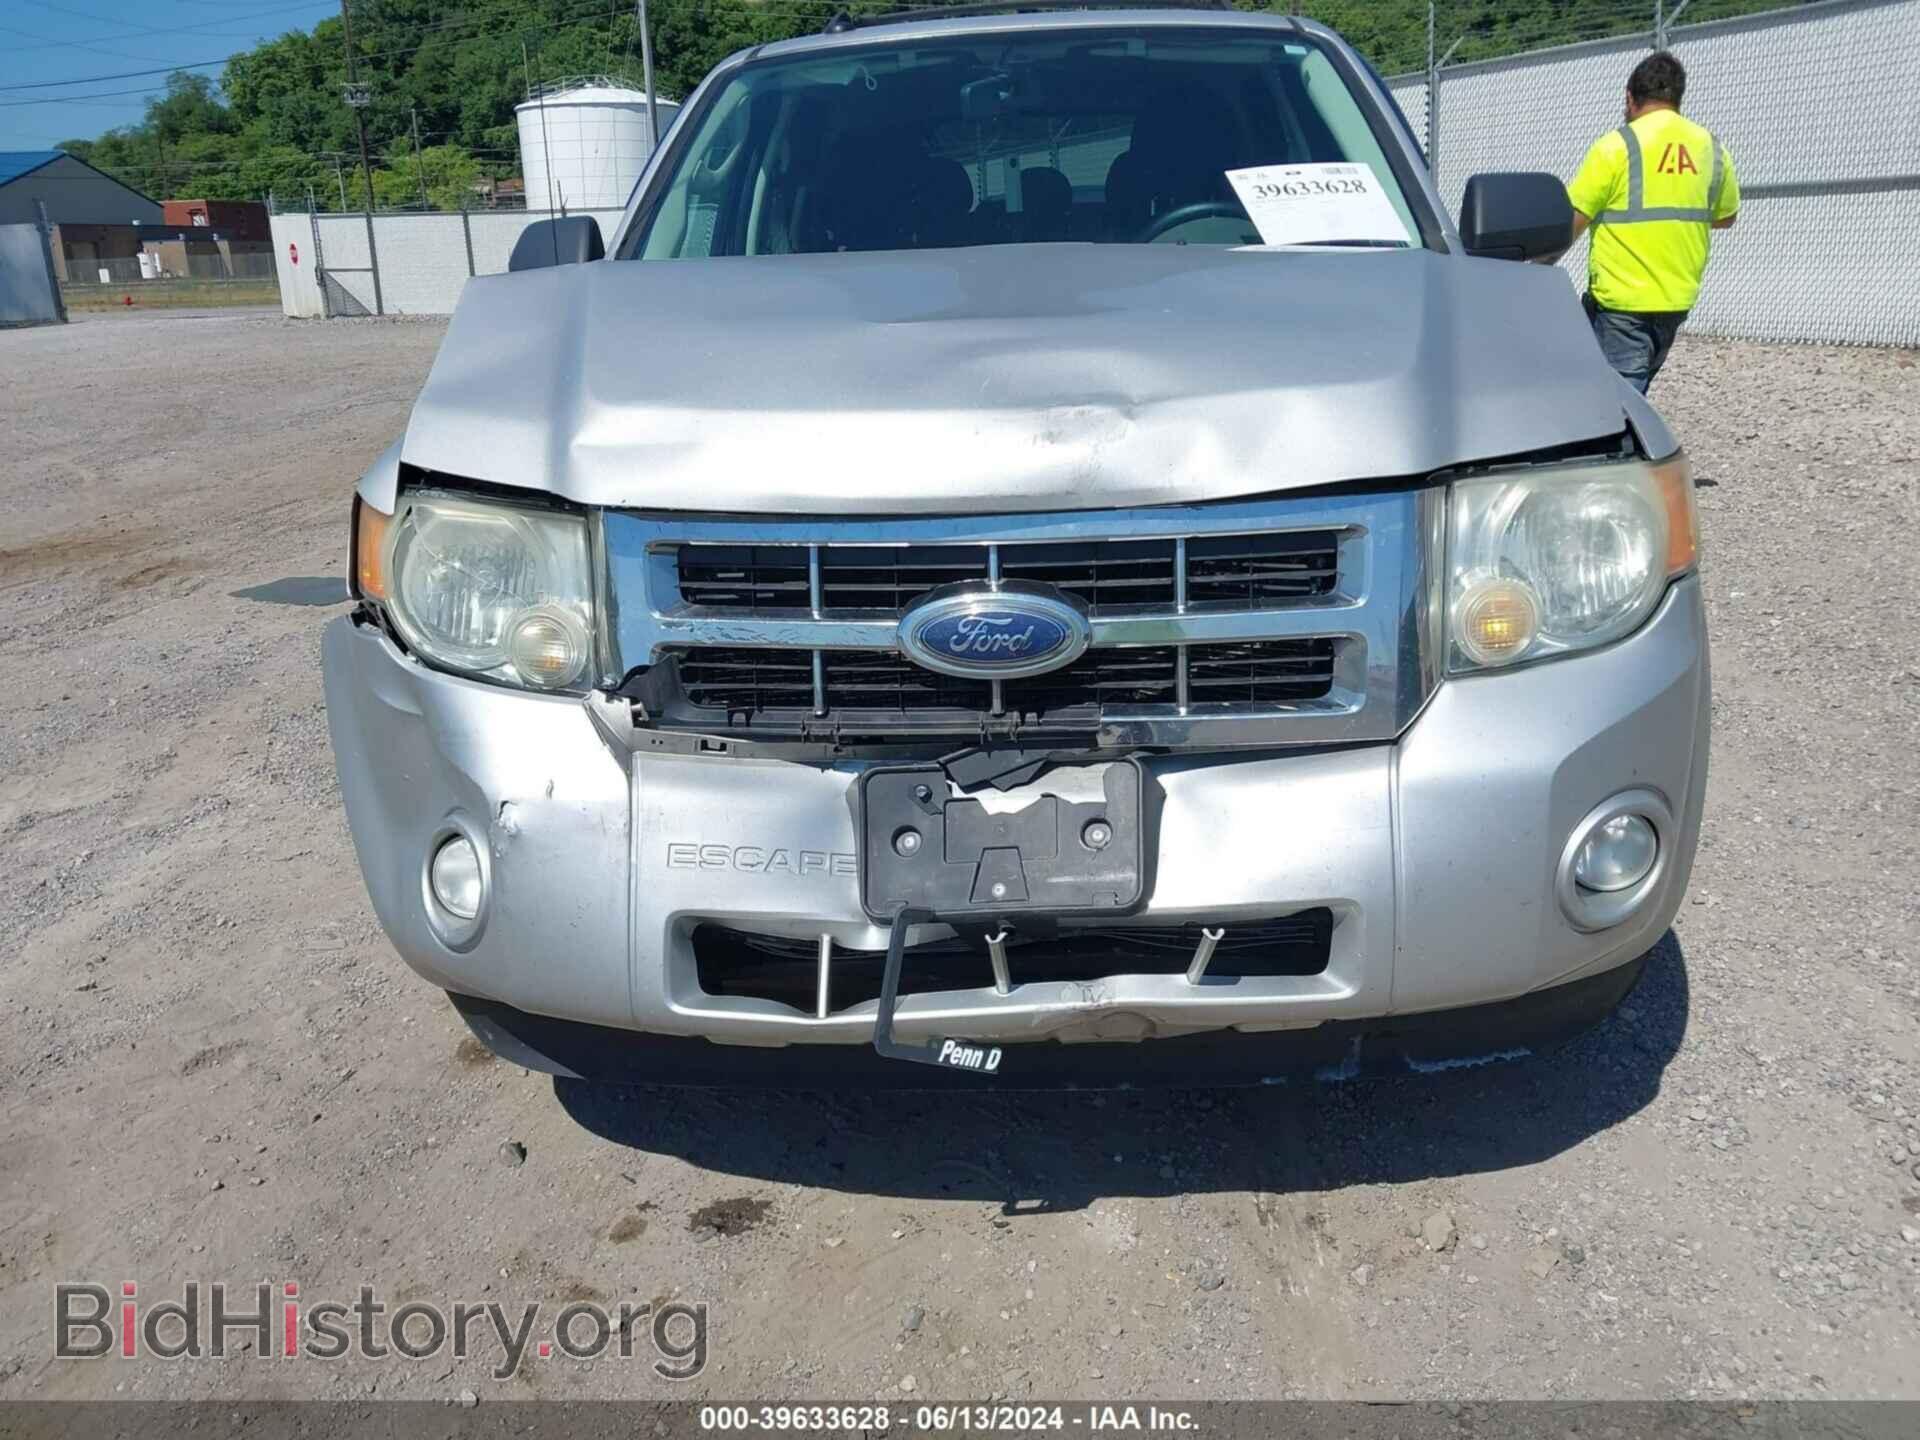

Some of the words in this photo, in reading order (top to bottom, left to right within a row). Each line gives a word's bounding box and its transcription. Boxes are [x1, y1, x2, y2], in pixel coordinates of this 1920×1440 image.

[1252, 179, 1368, 200] 39633628
[950, 615, 1035, 653] Ford
[666, 842, 857, 876] ESCAPE
[937, 1039, 985, 1069] Penn
[984, 1047, 1003, 1071] D
